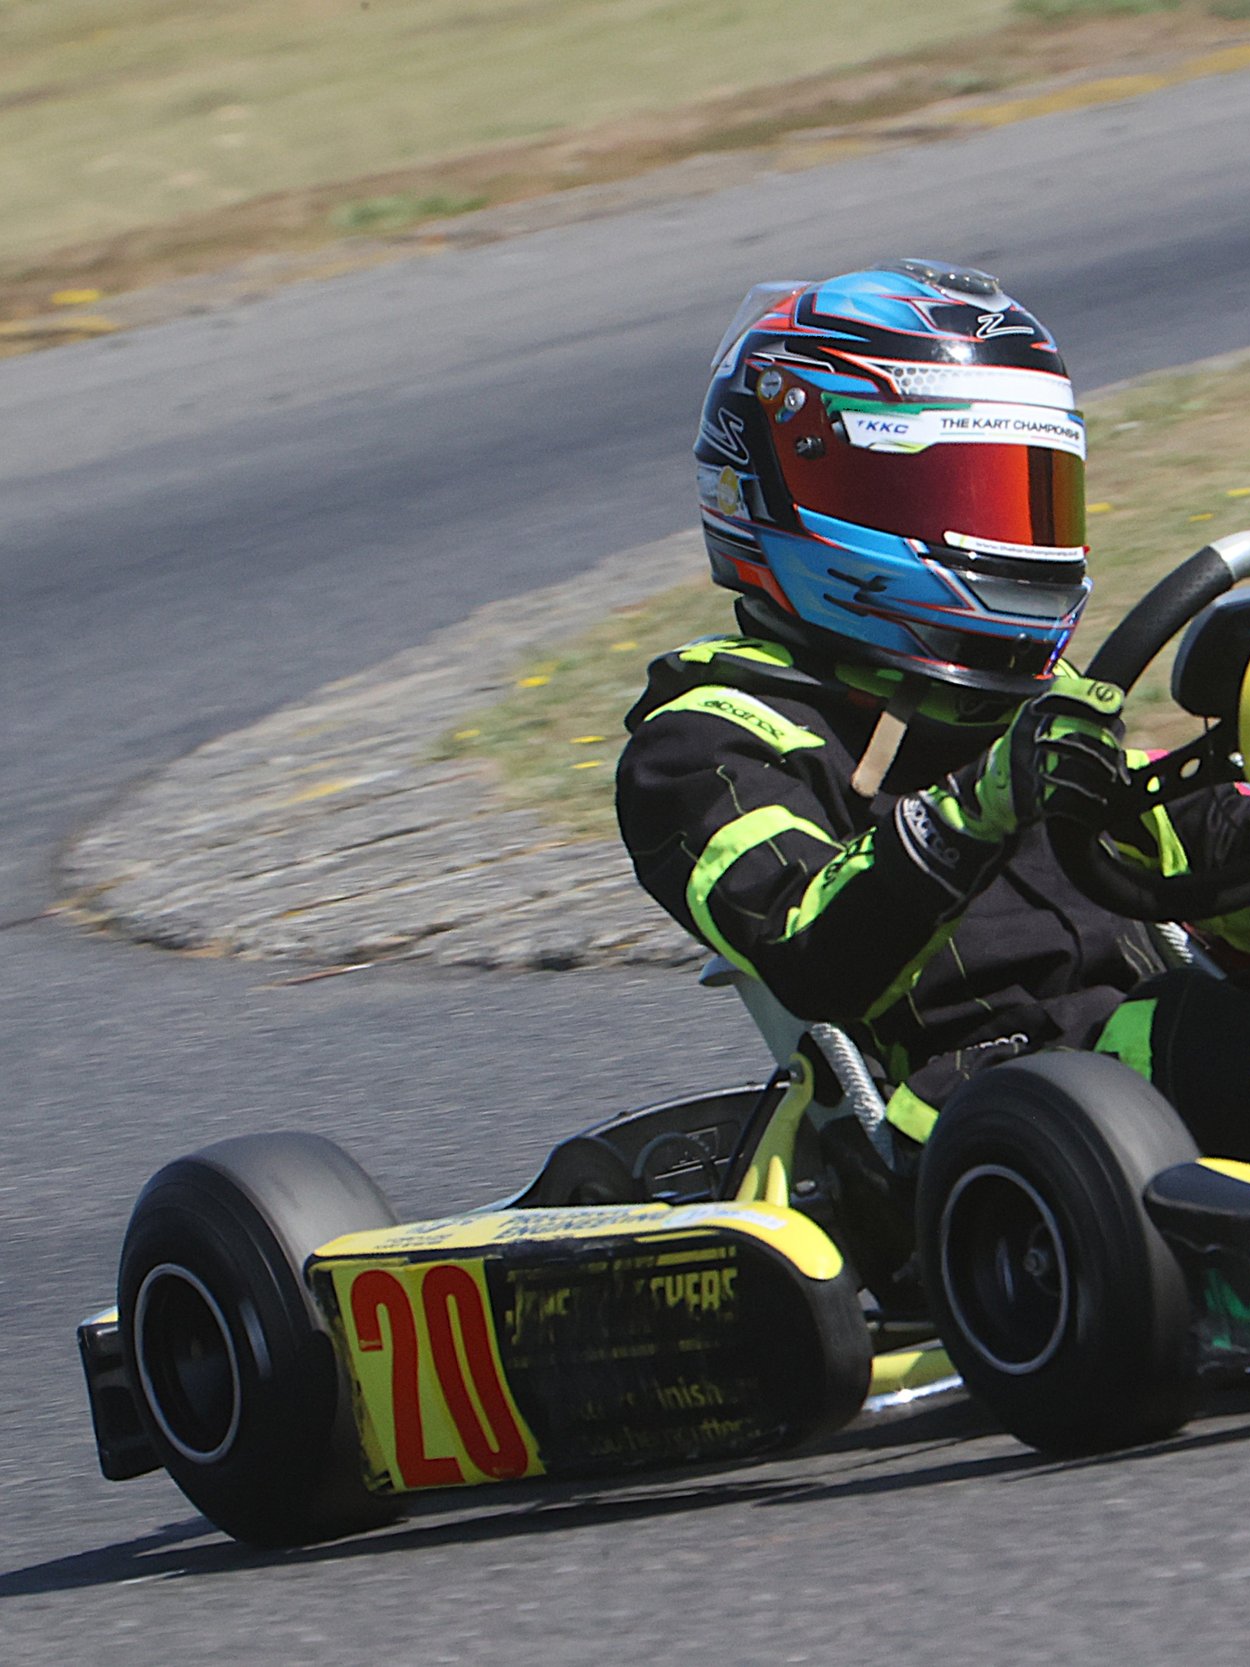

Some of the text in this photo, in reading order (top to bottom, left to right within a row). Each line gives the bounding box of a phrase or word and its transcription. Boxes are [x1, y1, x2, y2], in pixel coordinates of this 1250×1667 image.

[940, 417, 970, 429] THE
[972, 418, 1011, 430] KART
[351, 1264, 529, 1489] 20
